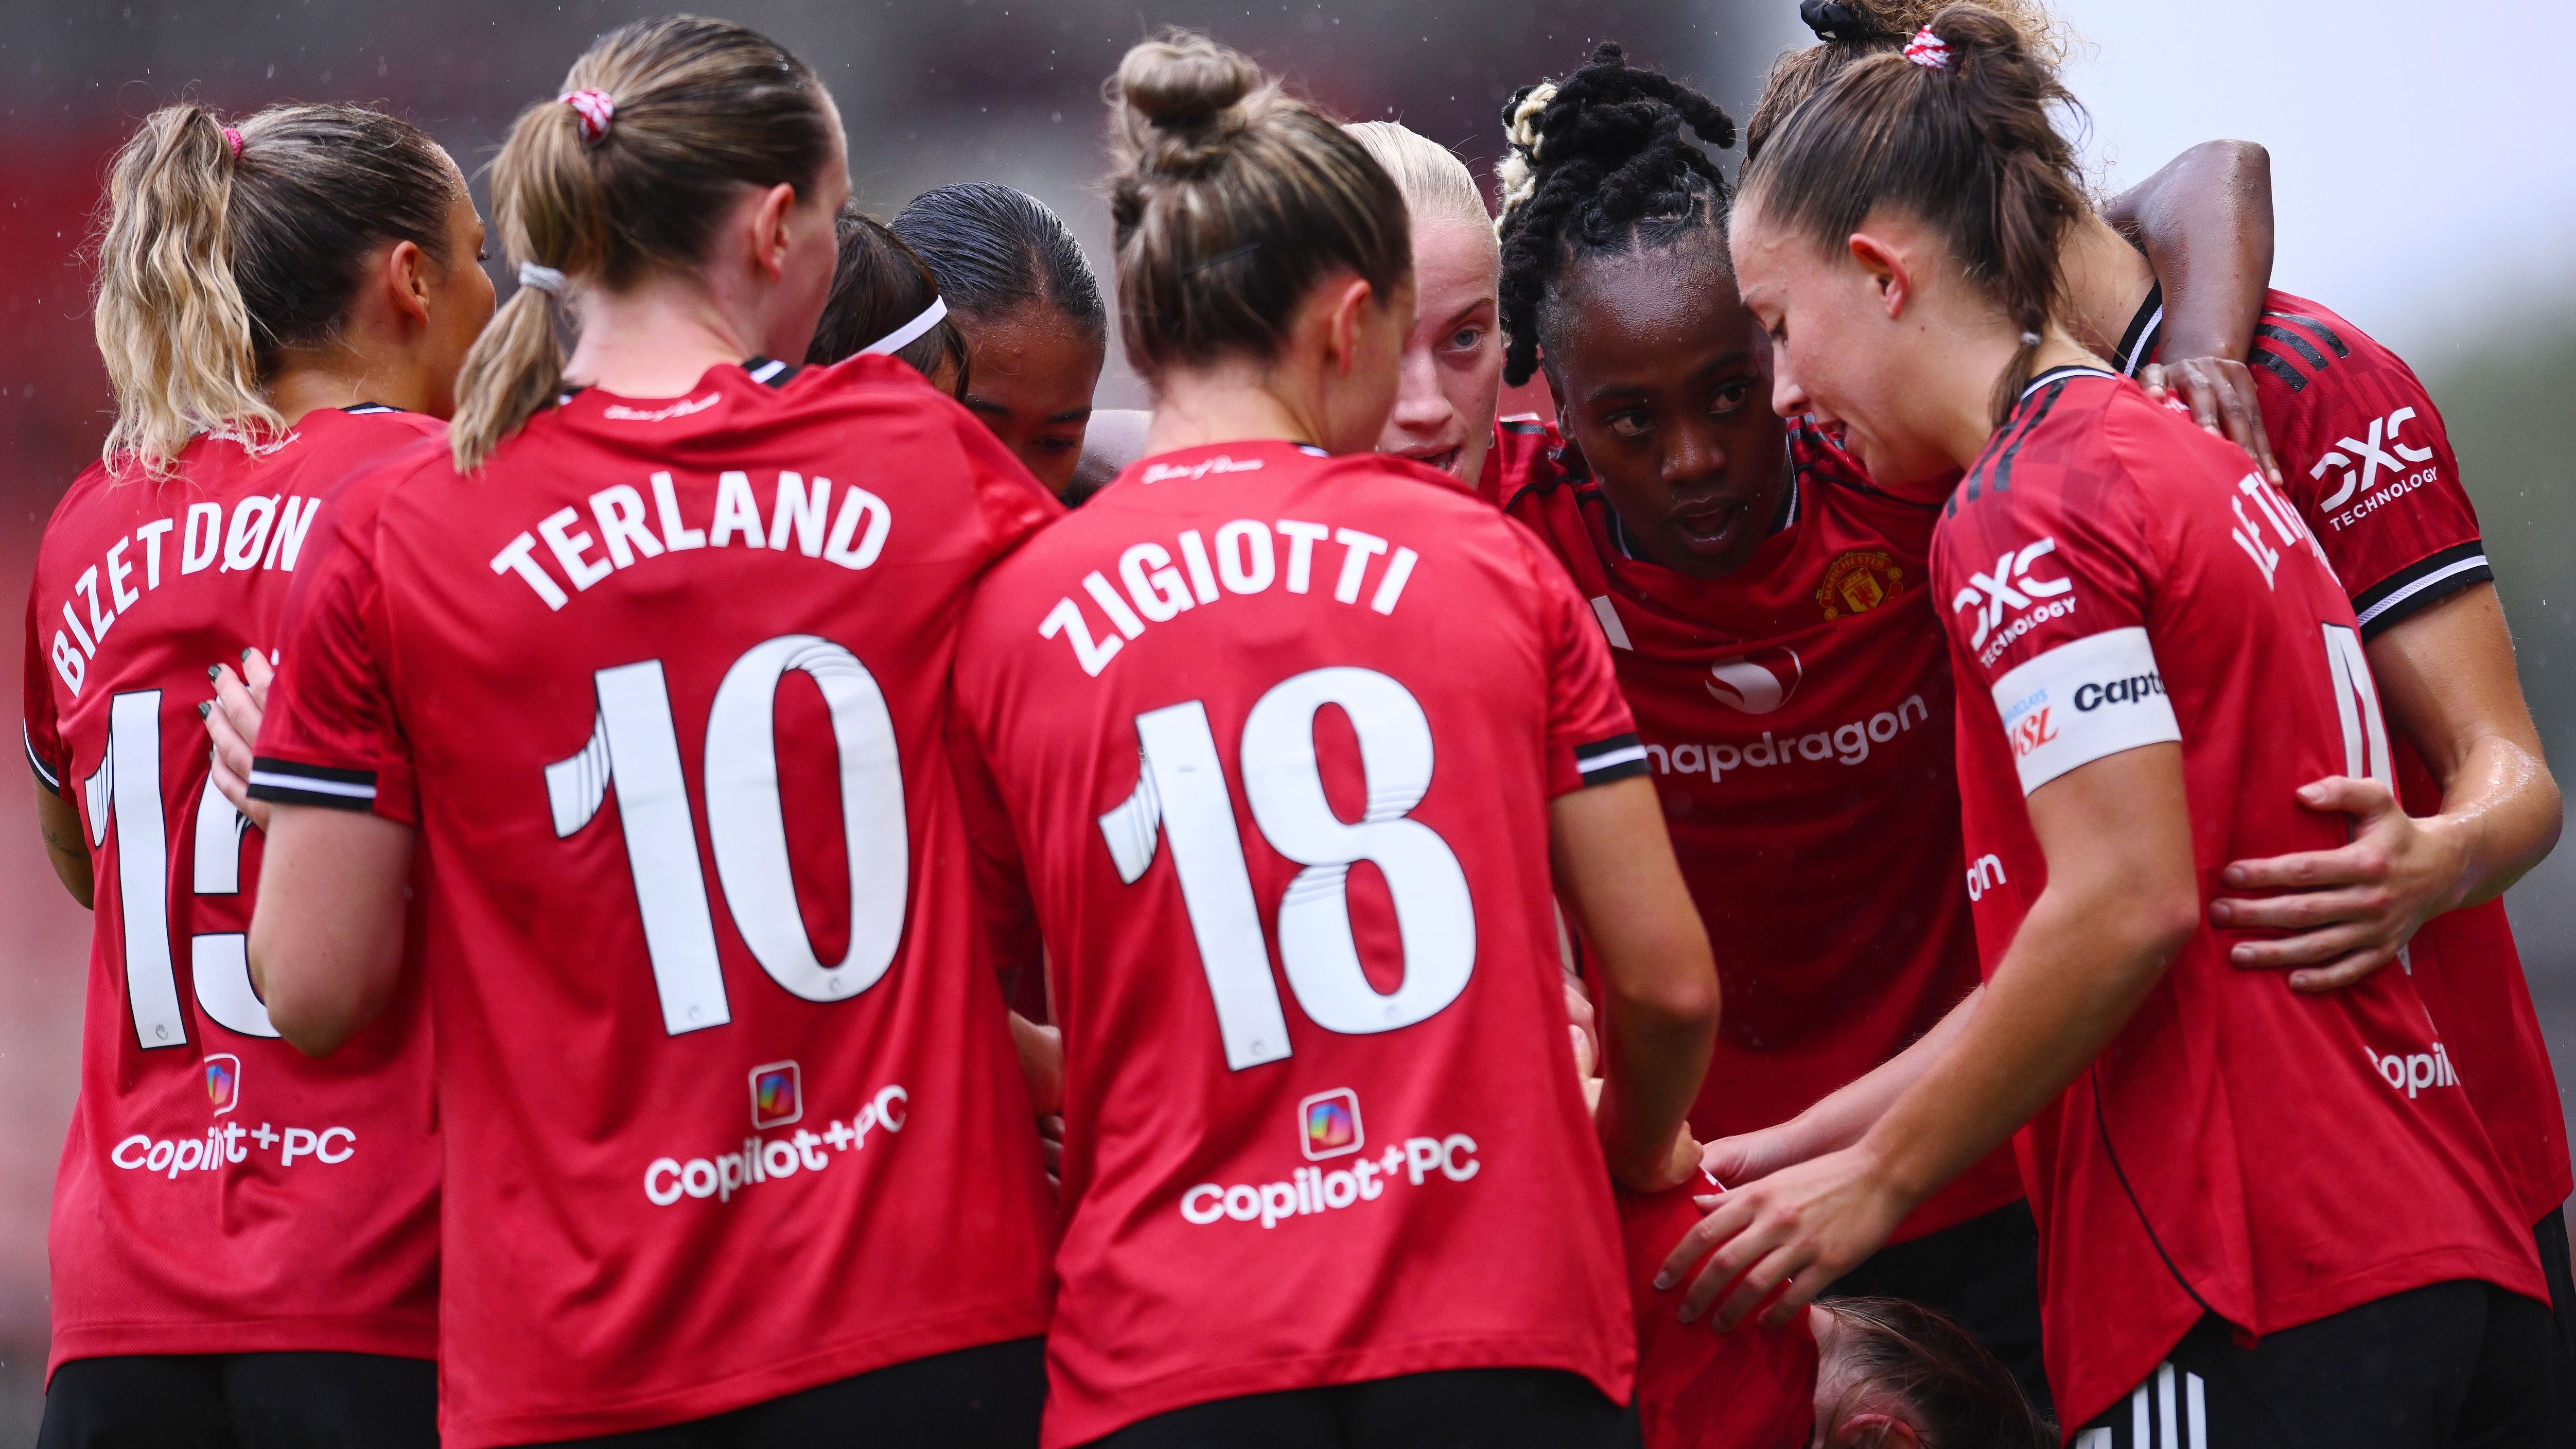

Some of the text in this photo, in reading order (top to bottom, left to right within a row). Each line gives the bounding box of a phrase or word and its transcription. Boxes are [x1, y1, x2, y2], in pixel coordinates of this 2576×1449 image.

[490, 470, 892, 612] TERLAND
[2329, 466, 2438, 531] TECHNOLOGY
[52, 493, 321, 699] BIZET DØN
[1038, 519, 1419, 677] ZIGIOTTI
[1979, 596, 2076, 669] TECHNOLOGY
[1646, 695, 1929, 783] napdragon
[2075, 671, 2166, 712] Capt
[544, 634, 909, 1036] 10
[1098, 666, 1477, 1072] 18
[2364, 1042, 2461, 1099] opil
